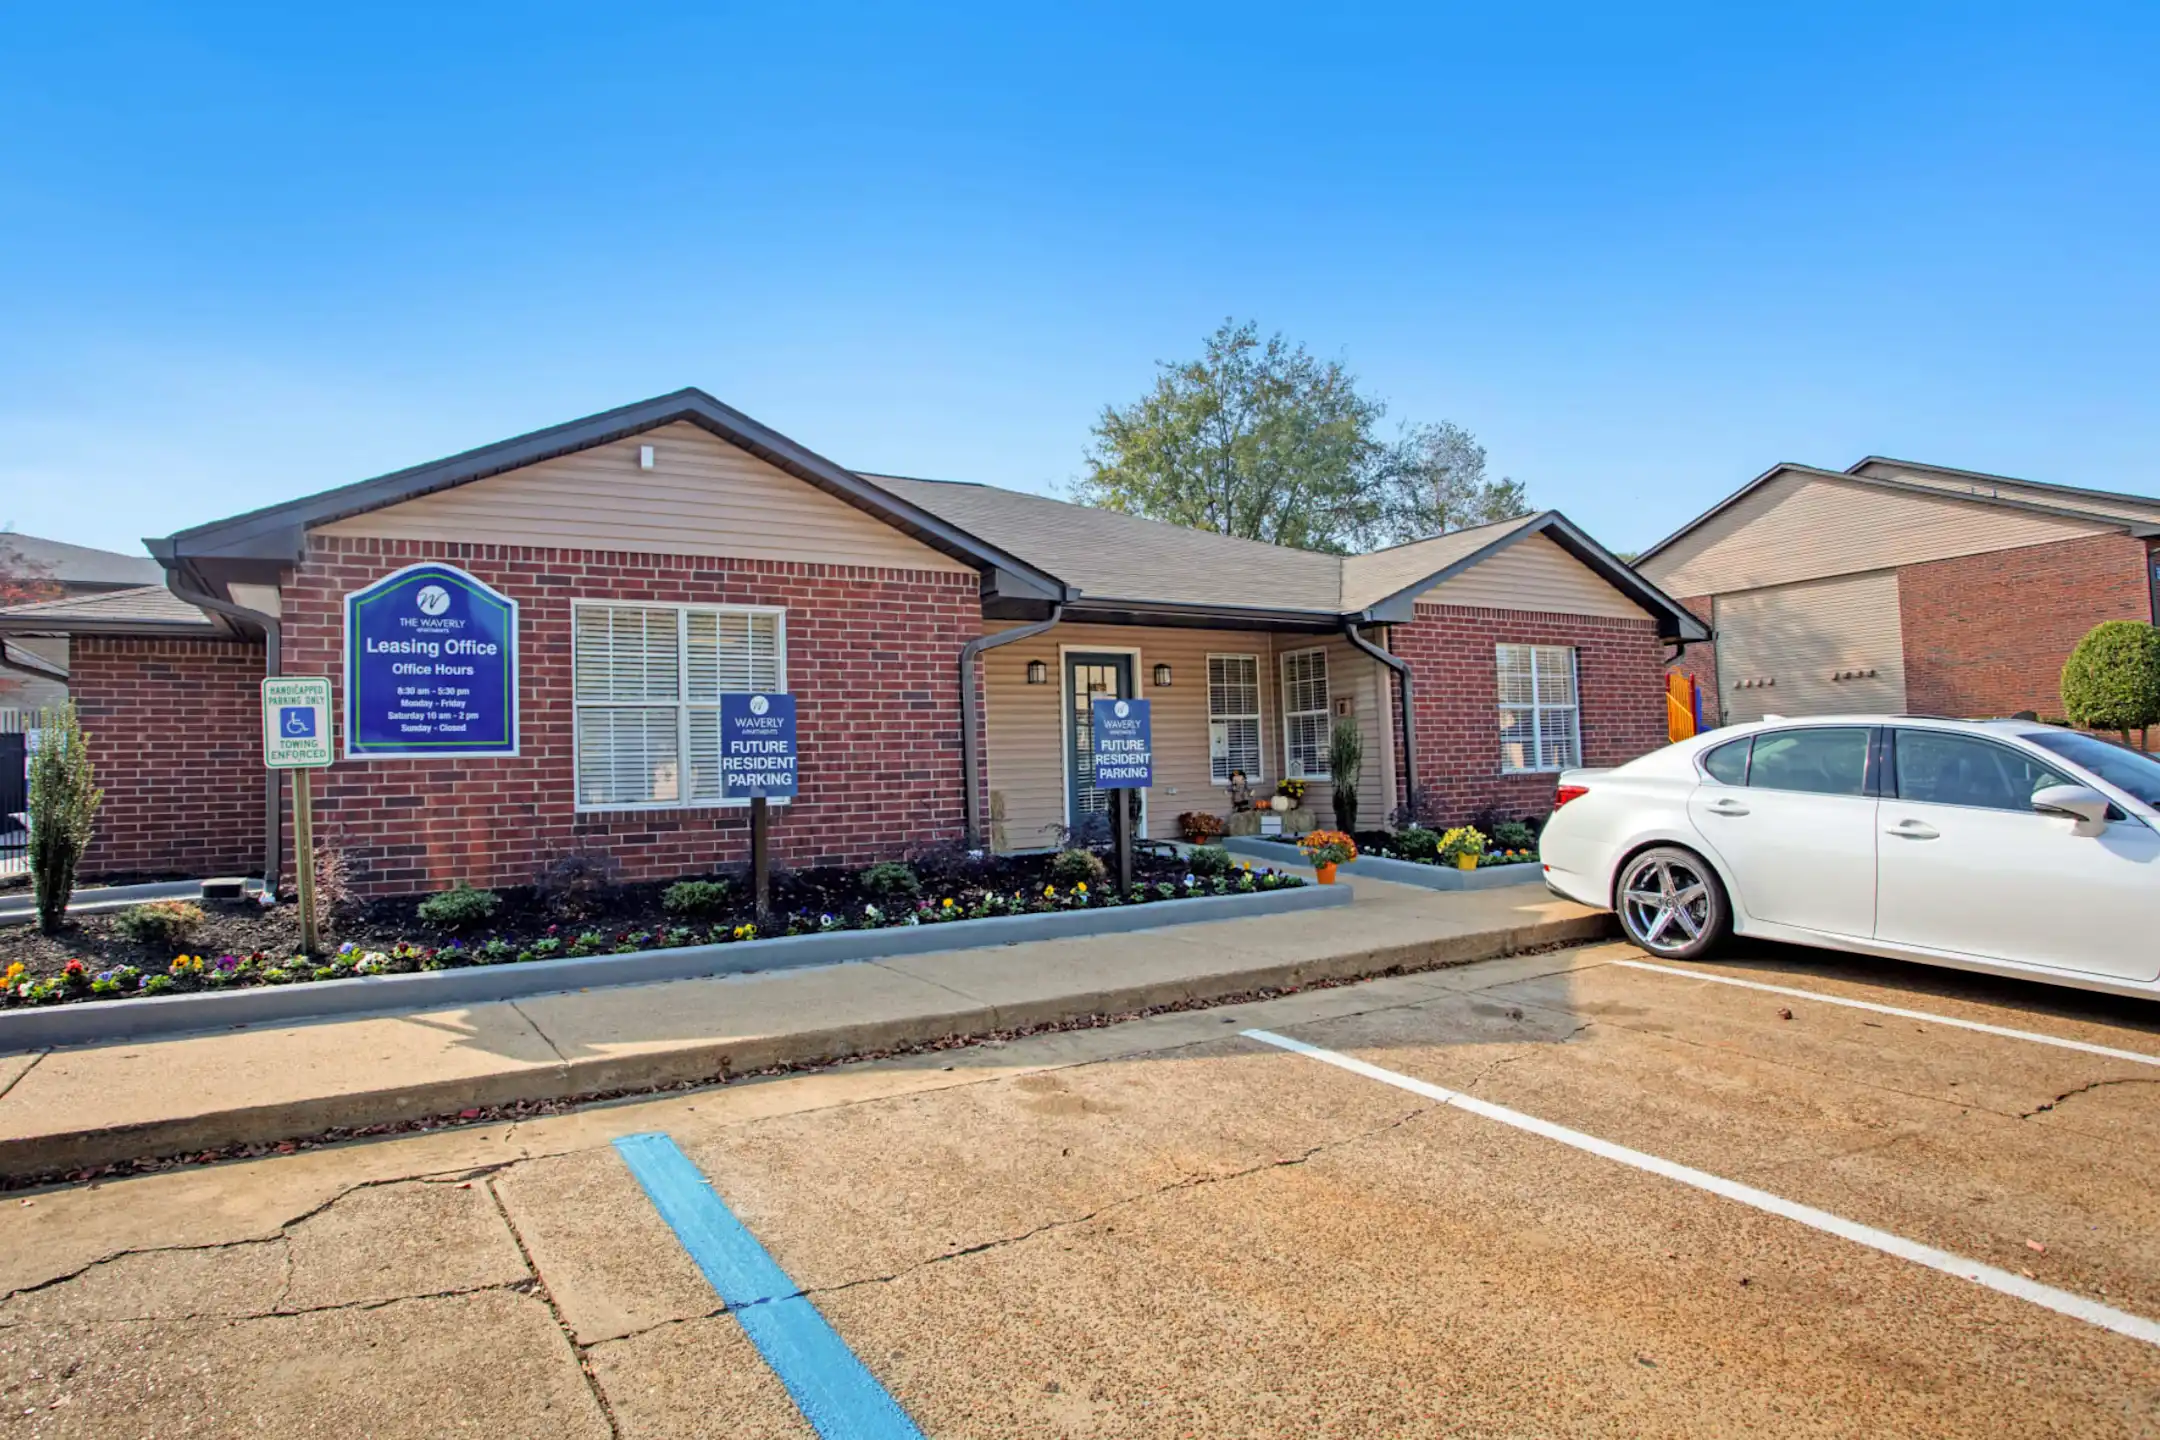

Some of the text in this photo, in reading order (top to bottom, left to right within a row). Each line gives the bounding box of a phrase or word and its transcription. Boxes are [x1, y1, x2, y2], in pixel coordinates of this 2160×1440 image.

[400, 617, 466, 628] THE WAVERLY
[366, 637, 497, 658] Leasing Office
[392, 663, 475, 676] Office Hours
[269, 685, 324, 696] HANDICAPPED
[397, 686, 416, 696] 8:30
[417, 688, 430, 696] am
[437, 687, 455, 696] 5:30
[457, 689, 470, 698] pm
[268, 696, 325, 705] PARKING ONLY
[400, 699, 433, 709] Monday
[440, 699, 466, 709] Friday
[388, 711, 425, 721] Saturday
[459, 711, 465, 720] 2
[466, 713, 479, 721] pm
[401, 723, 432, 733] Sunday
[439, 724, 467, 732] Closed
[734, 717, 784, 728] WAVERLY
[1103, 719, 1142, 729] WAVERLY
[280, 740, 318, 749] TOWING
[731, 740, 788, 754] FUTURE
[1100, 739, 1144, 752] FUTURE
[271, 749, 326, 760] ENFORCED
[1095, 752, 1151, 766] RESIDENT
[723, 756, 796, 770] RESIDENT
[1099, 767, 1148, 780] PARKING
[728, 772, 792, 787] PARKING
